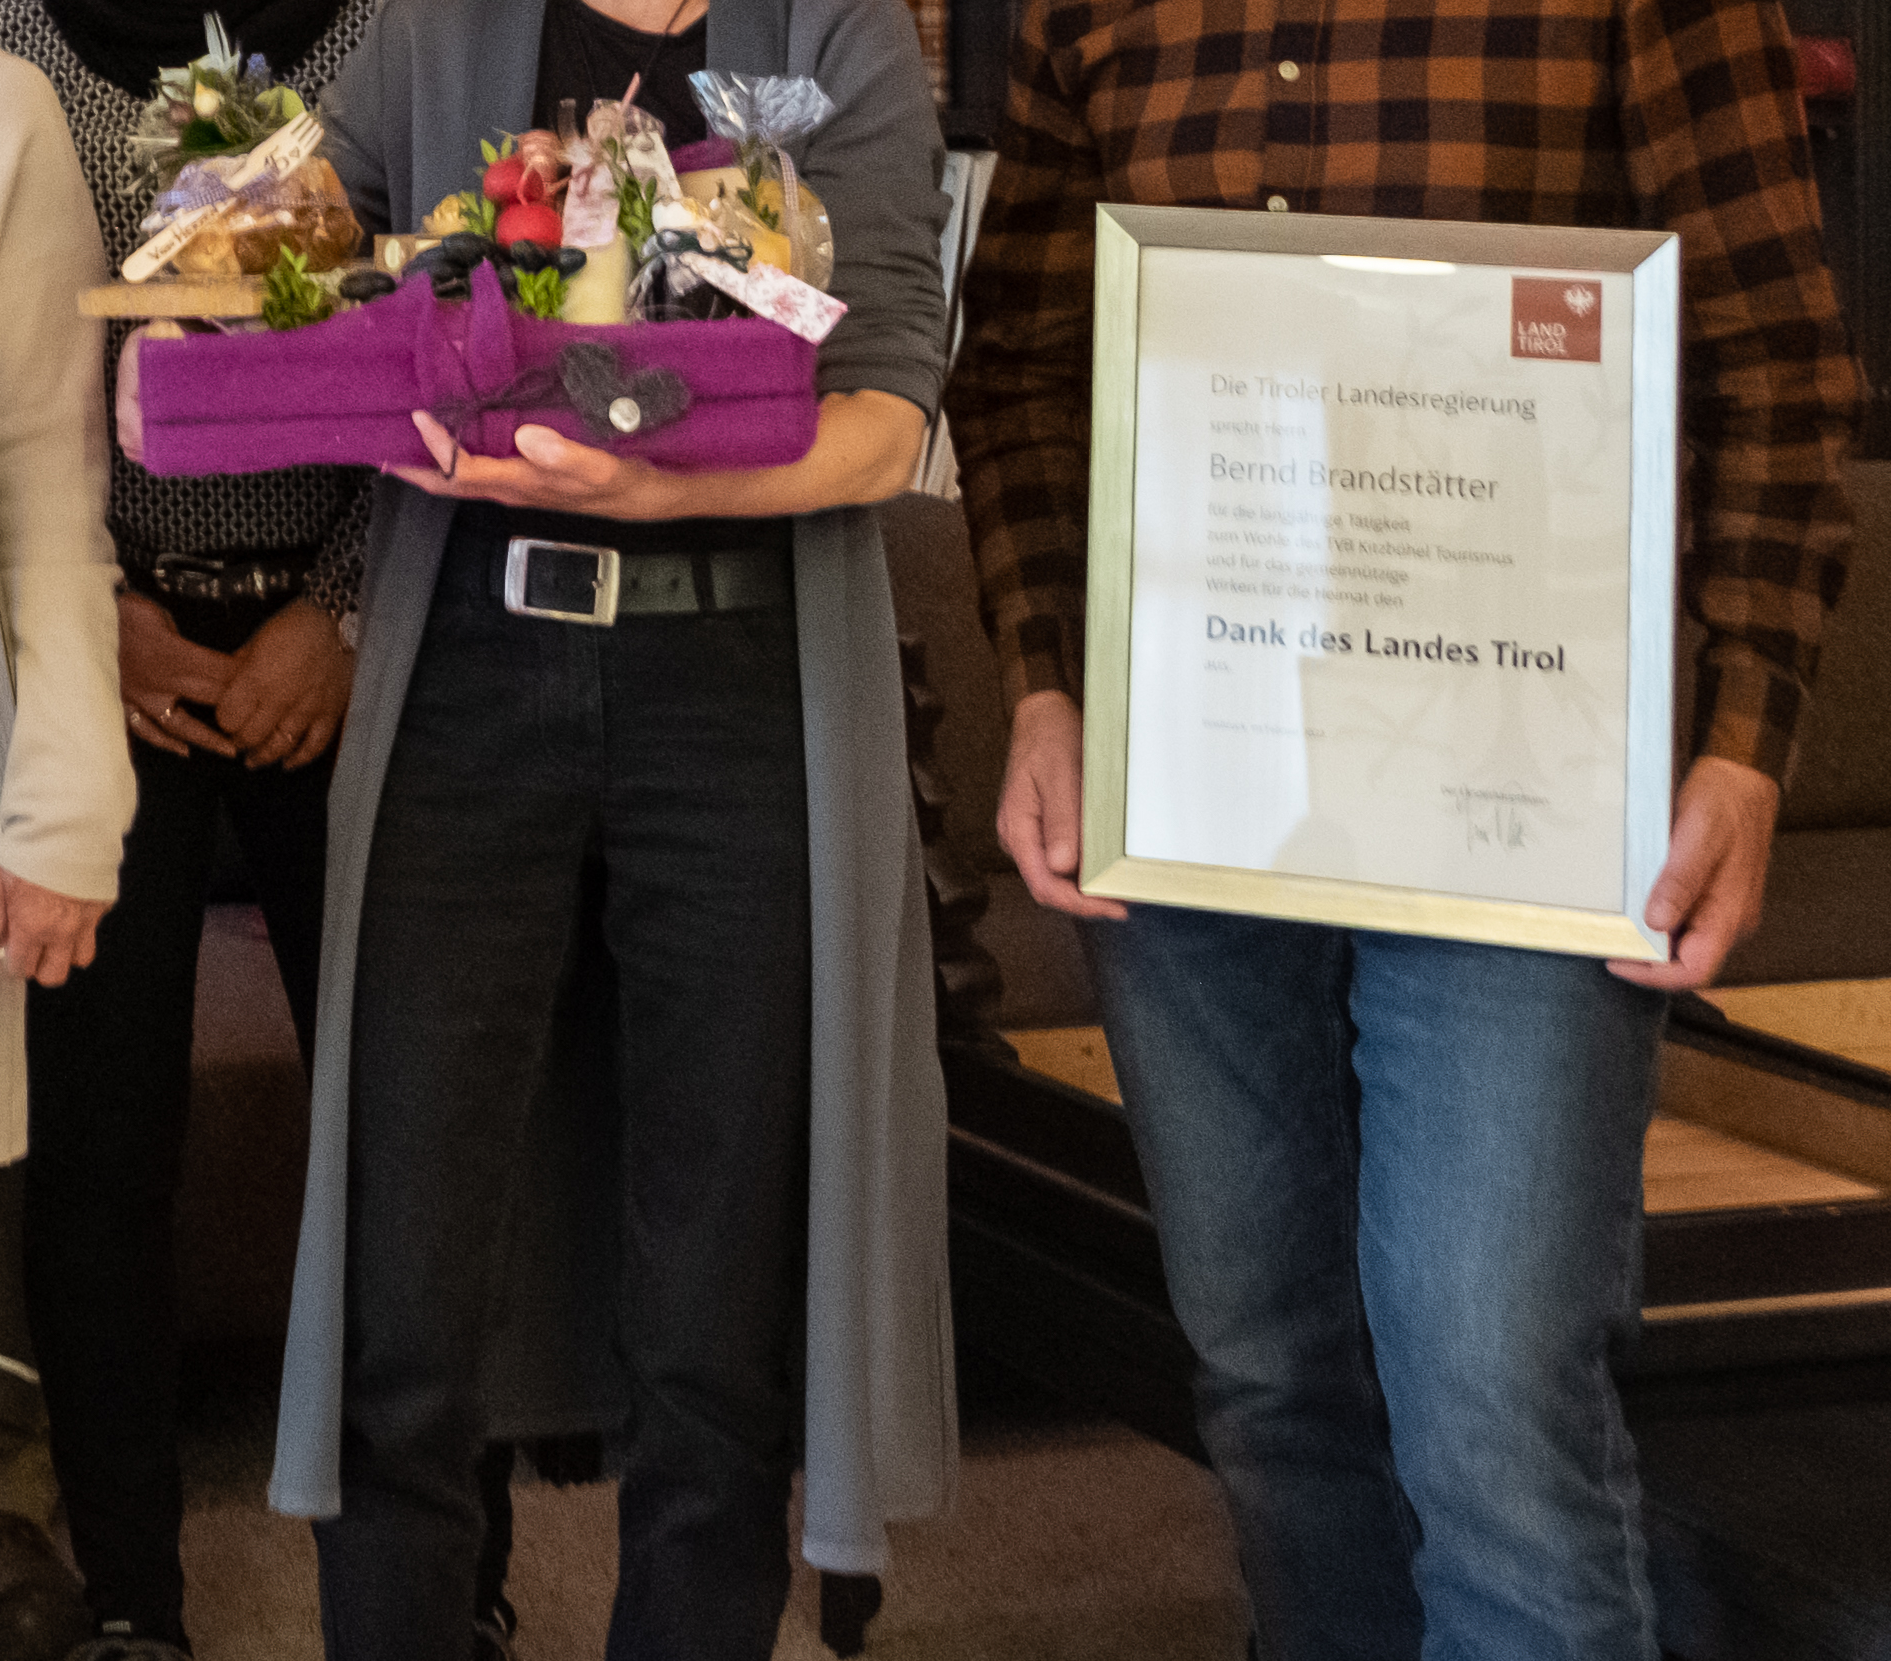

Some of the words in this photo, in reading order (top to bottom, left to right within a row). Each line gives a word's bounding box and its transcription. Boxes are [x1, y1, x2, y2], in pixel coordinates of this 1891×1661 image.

[1517, 320, 1567, 339] LAND
[1517, 336, 1568, 356] TIROL
[1211, 373, 1247, 398] Die
[1255, 375, 1329, 402] Tiroler
[1337, 382, 1537, 422] Landesregierung
[1210, 452, 1296, 486] Bernd
[1308, 459, 1499, 501] Brandstätter
[1349, 512, 1410, 533] Tätigkeit
[1327, 537, 1355, 552] TVB
[1359, 539, 1430, 559] Kitzbühel
[1435, 544, 1514, 566] Tourismus
[1205, 576, 1257, 595] Wirken
[1262, 581, 1282, 597] für
[1315, 586, 1369, 605] Heimat
[1374, 590, 1404, 608] den
[1206, 614, 1286, 647] Dank
[1298, 622, 1353, 653] des
[1365, 628, 1480, 666] Landes
[1490, 639, 1565, 673] Tirol
